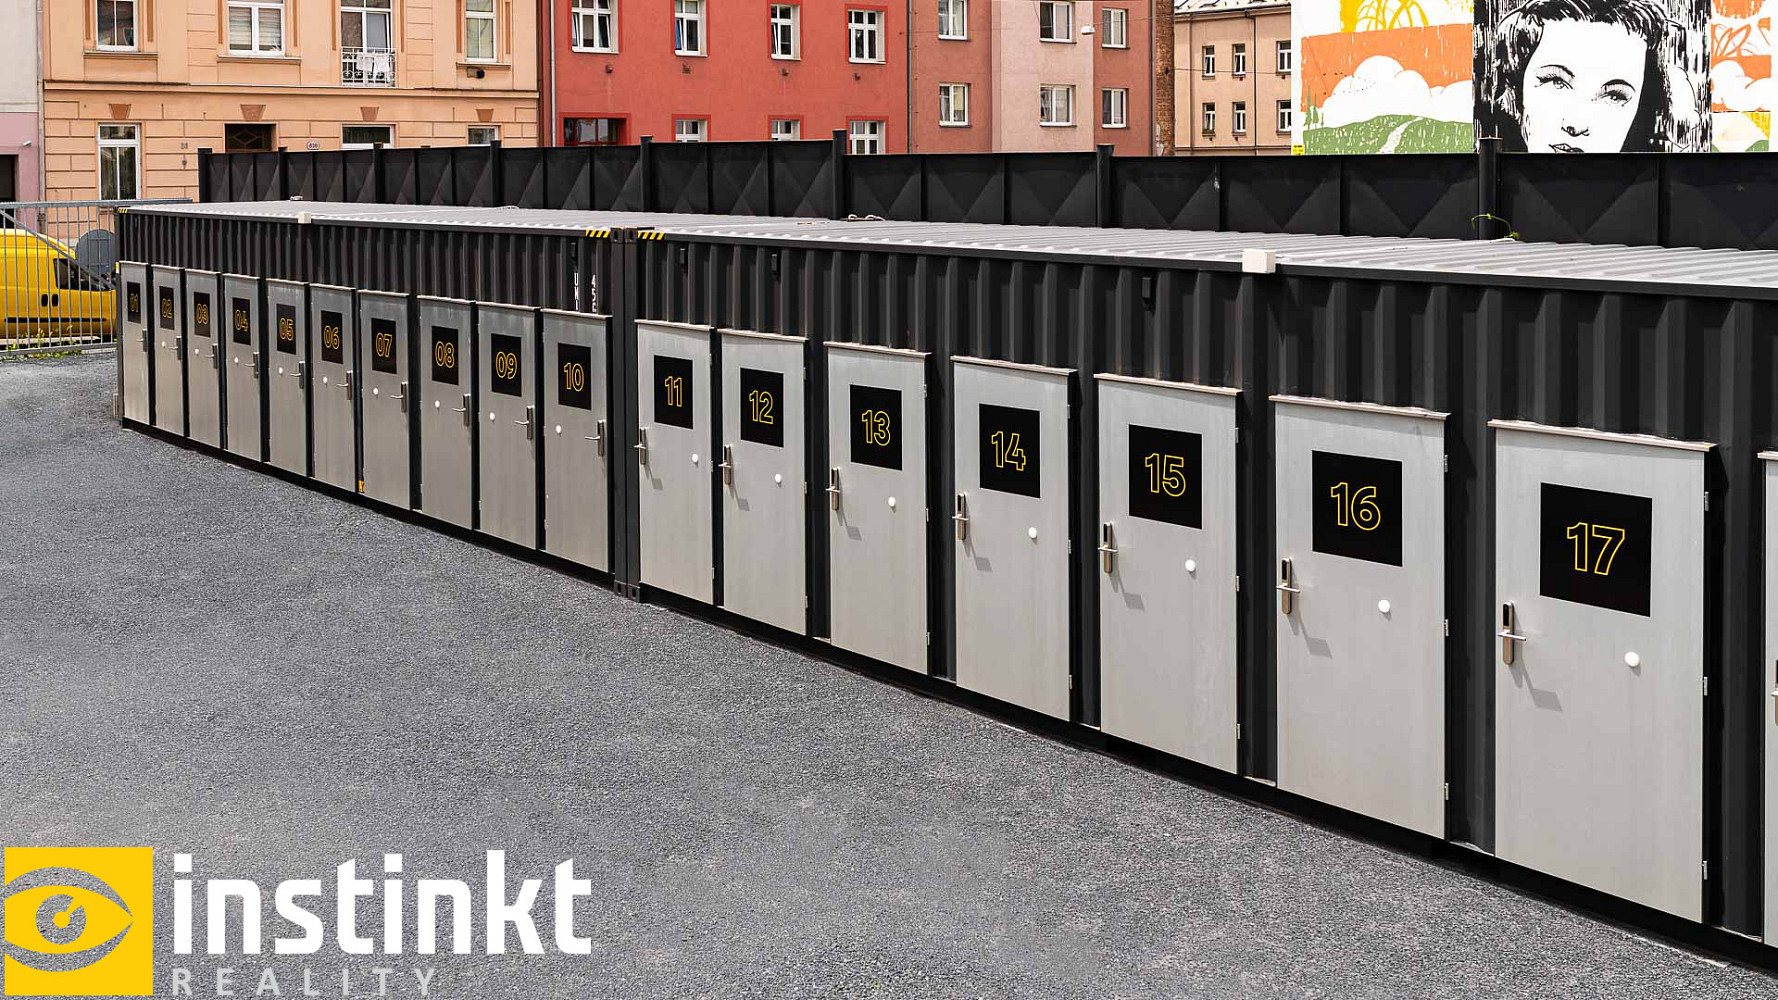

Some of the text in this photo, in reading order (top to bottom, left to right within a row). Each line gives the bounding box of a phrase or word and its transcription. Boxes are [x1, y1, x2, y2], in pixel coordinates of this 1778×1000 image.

[130, 293, 139, 313] 01
[162, 298, 174, 319] 02
[196, 303, 209, 325] 03
[234, 310, 248, 332] 04
[280, 317, 294, 342] 05
[324, 325, 340, 350] 06
[376, 332, 393, 358] 07
[435, 341, 454, 368] 08
[496, 352, 517, 379] 09
[564, 363, 584, 393] 10
[665, 376, 683, 407] 11
[749, 390, 773, 424] 12
[862, 410, 890, 446] 13
[991, 431, 1026, 471] 14
[1145, 453, 1186, 497] 15
[1331, 482, 1381, 530] 16
[1567, 522, 1625, 575] 17
